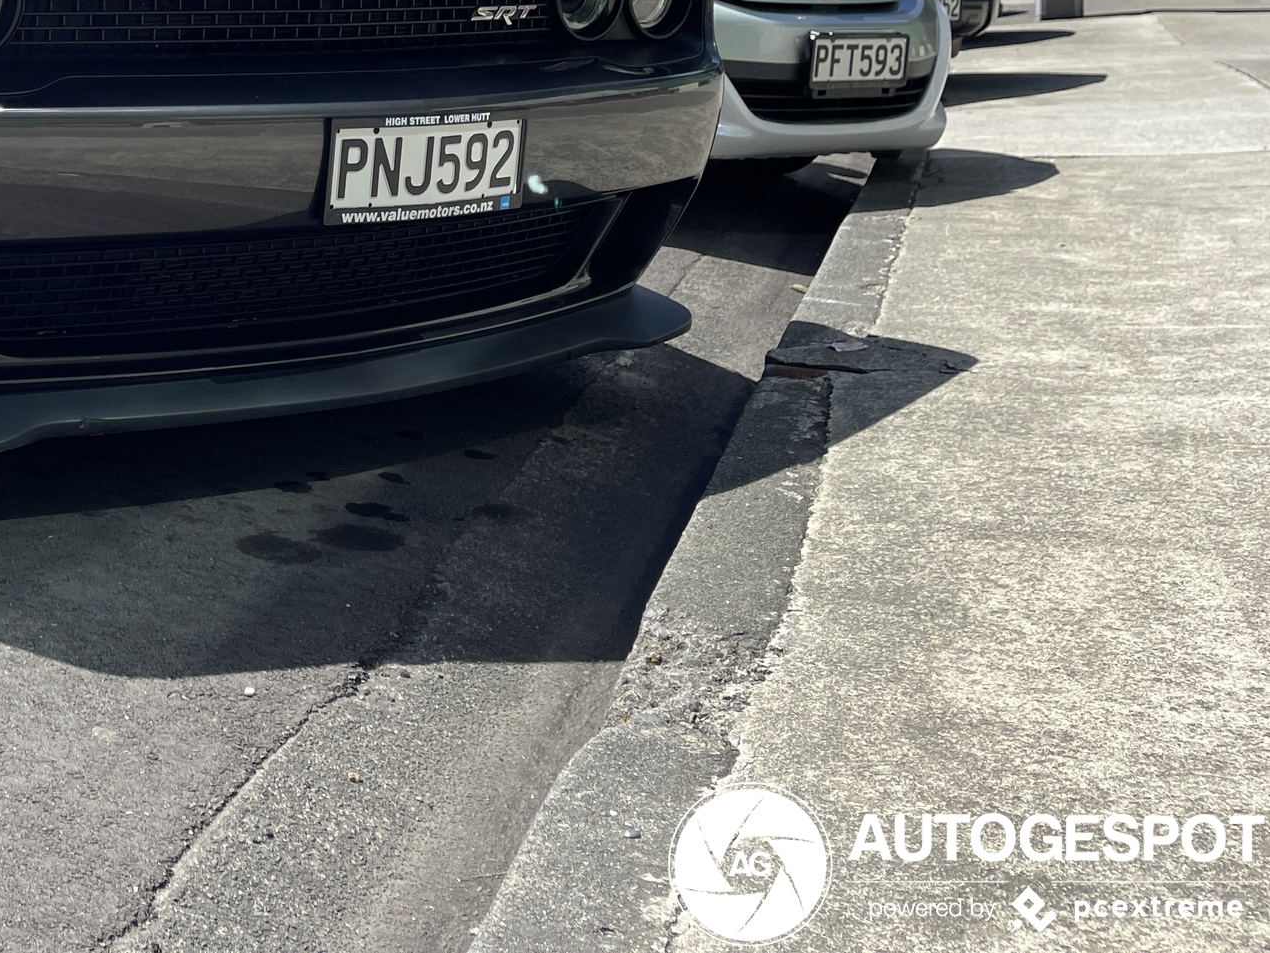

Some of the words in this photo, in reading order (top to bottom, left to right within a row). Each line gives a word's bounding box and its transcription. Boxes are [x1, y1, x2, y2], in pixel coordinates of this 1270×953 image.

[470, 5, 538, 26] SRT
[814, 43, 904, 78] PFT593
[385, 117, 408, 127] HIGH
[409, 115, 441, 126] STREET
[444, 113, 471, 124] LOWER
[471, 112, 491, 123] HUTT
[337, 129, 516, 199] PNJ592
[341, 200, 494, 224] www.valuemotors.co.nz
